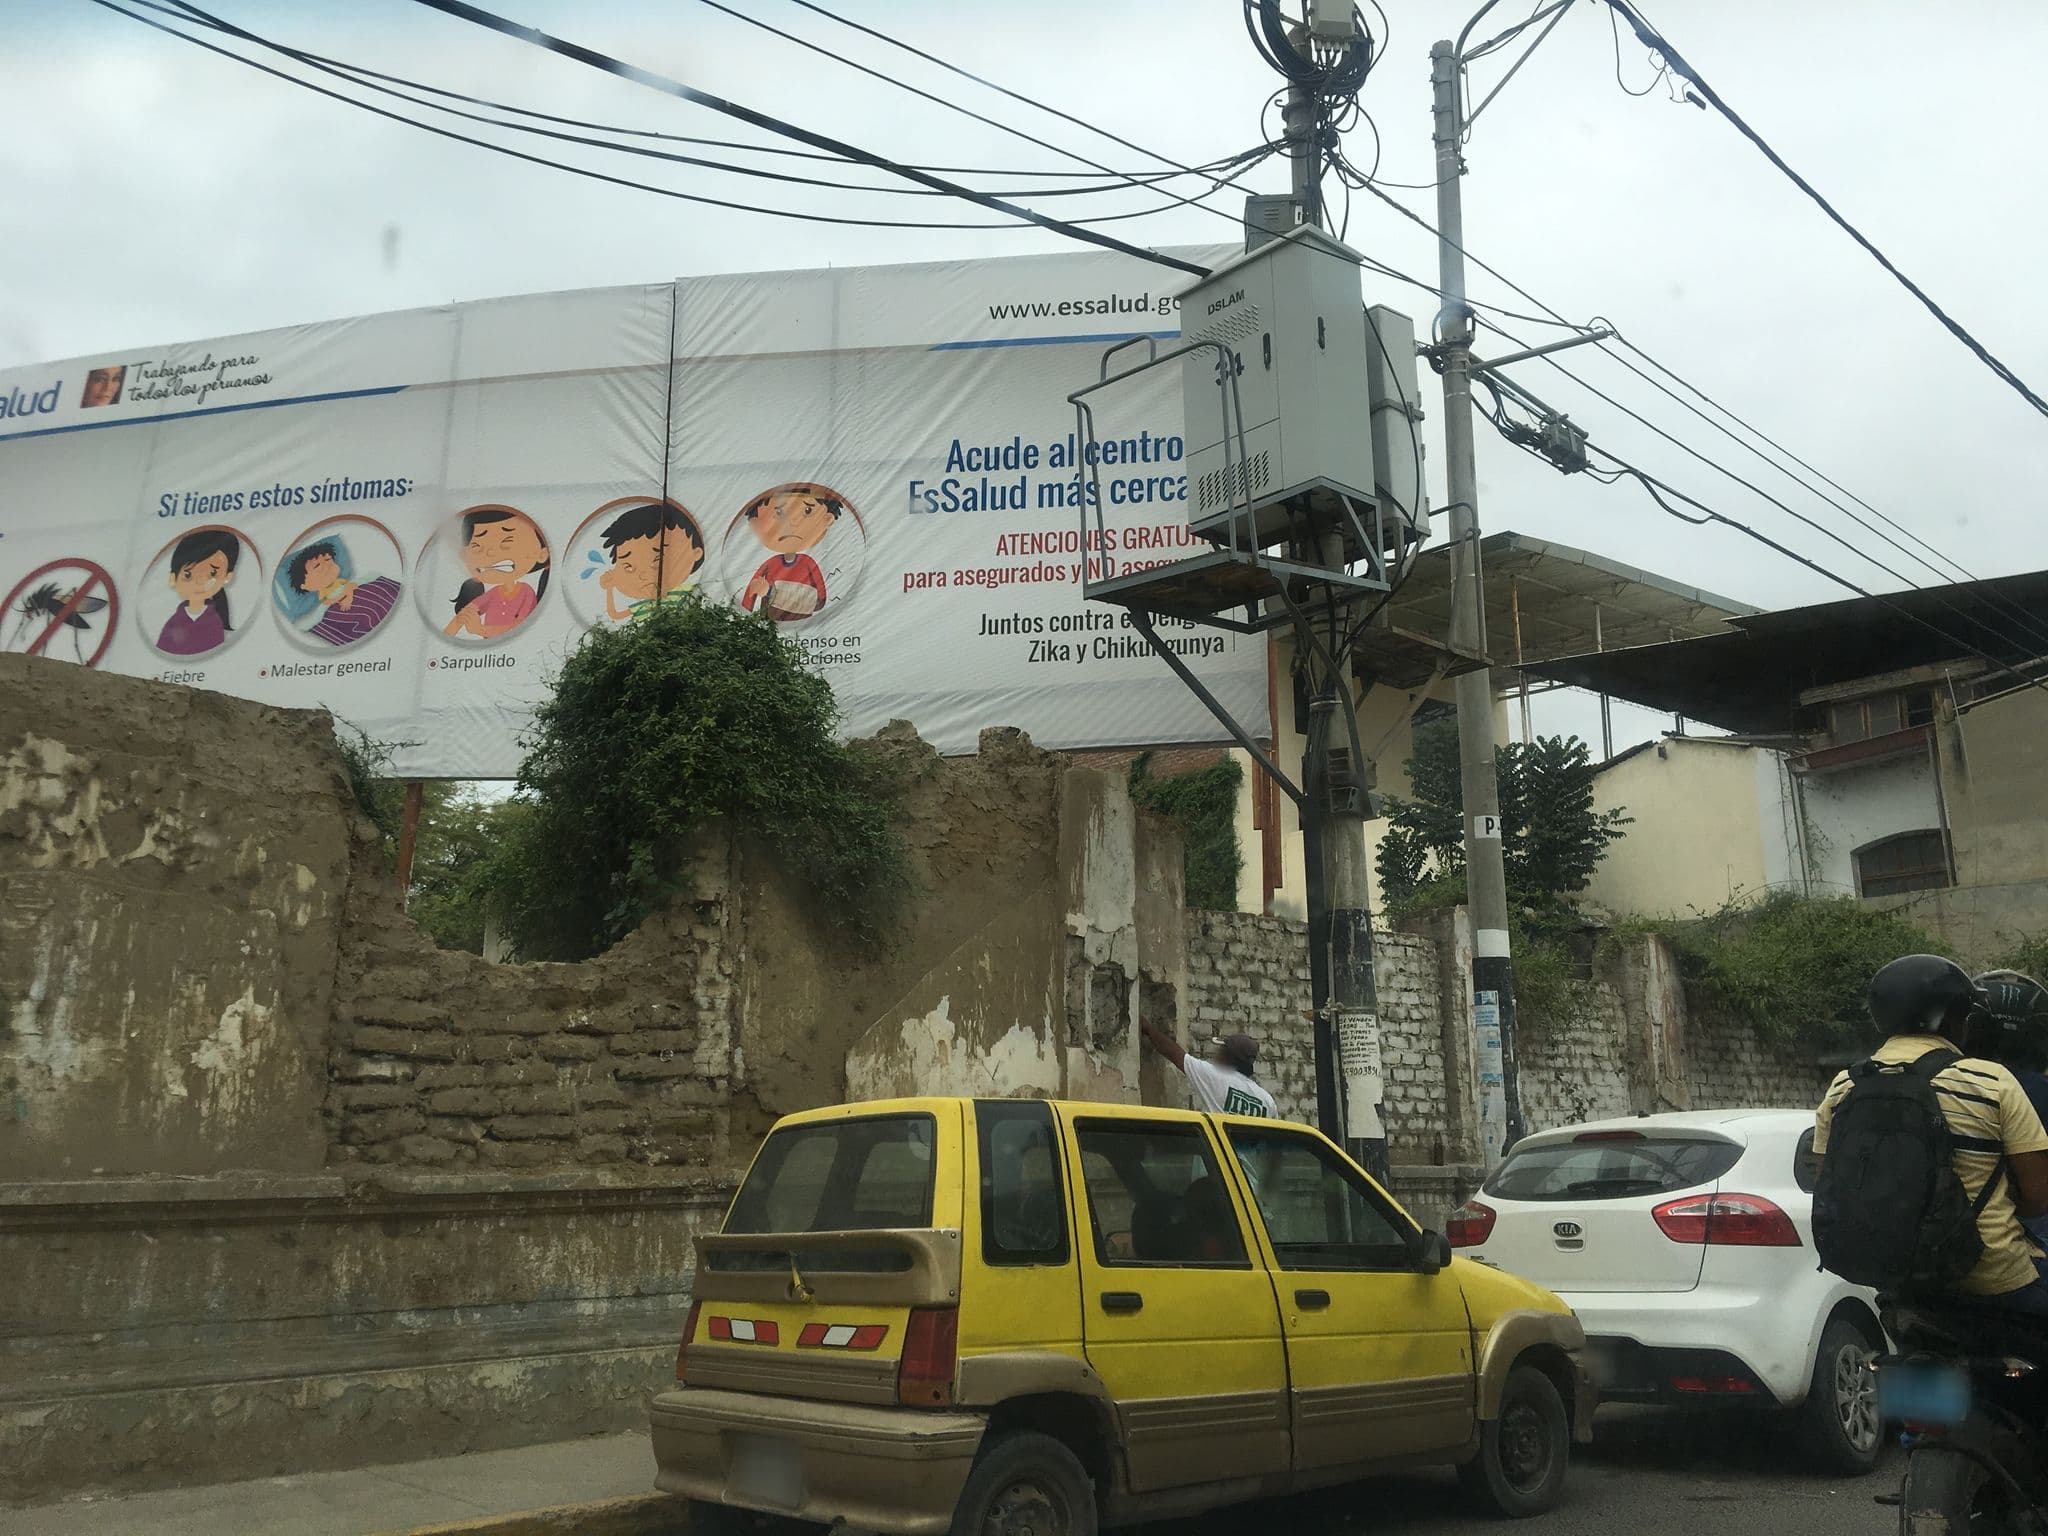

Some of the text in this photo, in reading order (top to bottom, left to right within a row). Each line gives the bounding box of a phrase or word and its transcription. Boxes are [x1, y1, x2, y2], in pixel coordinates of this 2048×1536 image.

[1207, 288, 1246, 316] DSLAM
[130, 353, 260, 387] Trabajando para
[128, 373, 273, 405] todos los peruanos
[945, 430, 1184, 474] Acude al centro
[158, 476, 414, 518] Si tienes estos síntomas:
[908, 475, 1027, 515] EsSalud
[1037, 472, 1098, 509] más
[995, 528, 1117, 556] ATENCIONES
[903, 570, 947, 593] para
[953, 560, 1066, 589] asegurados
[1071, 563, 1082, 584] y
[978, 612, 1044, 636] Juntos
[1049, 609, 1114, 632] contra
[842, 635, 862, 648] en
[1028, 639, 1071, 663] Zika
[1076, 643, 1088, 664] y
[162, 669, 206, 684] Fiebre
[270, 657, 392, 679] Malestar general
[439, 653, 516, 672] Sarpullido
[1557, 1224, 1577, 1235] KIA
